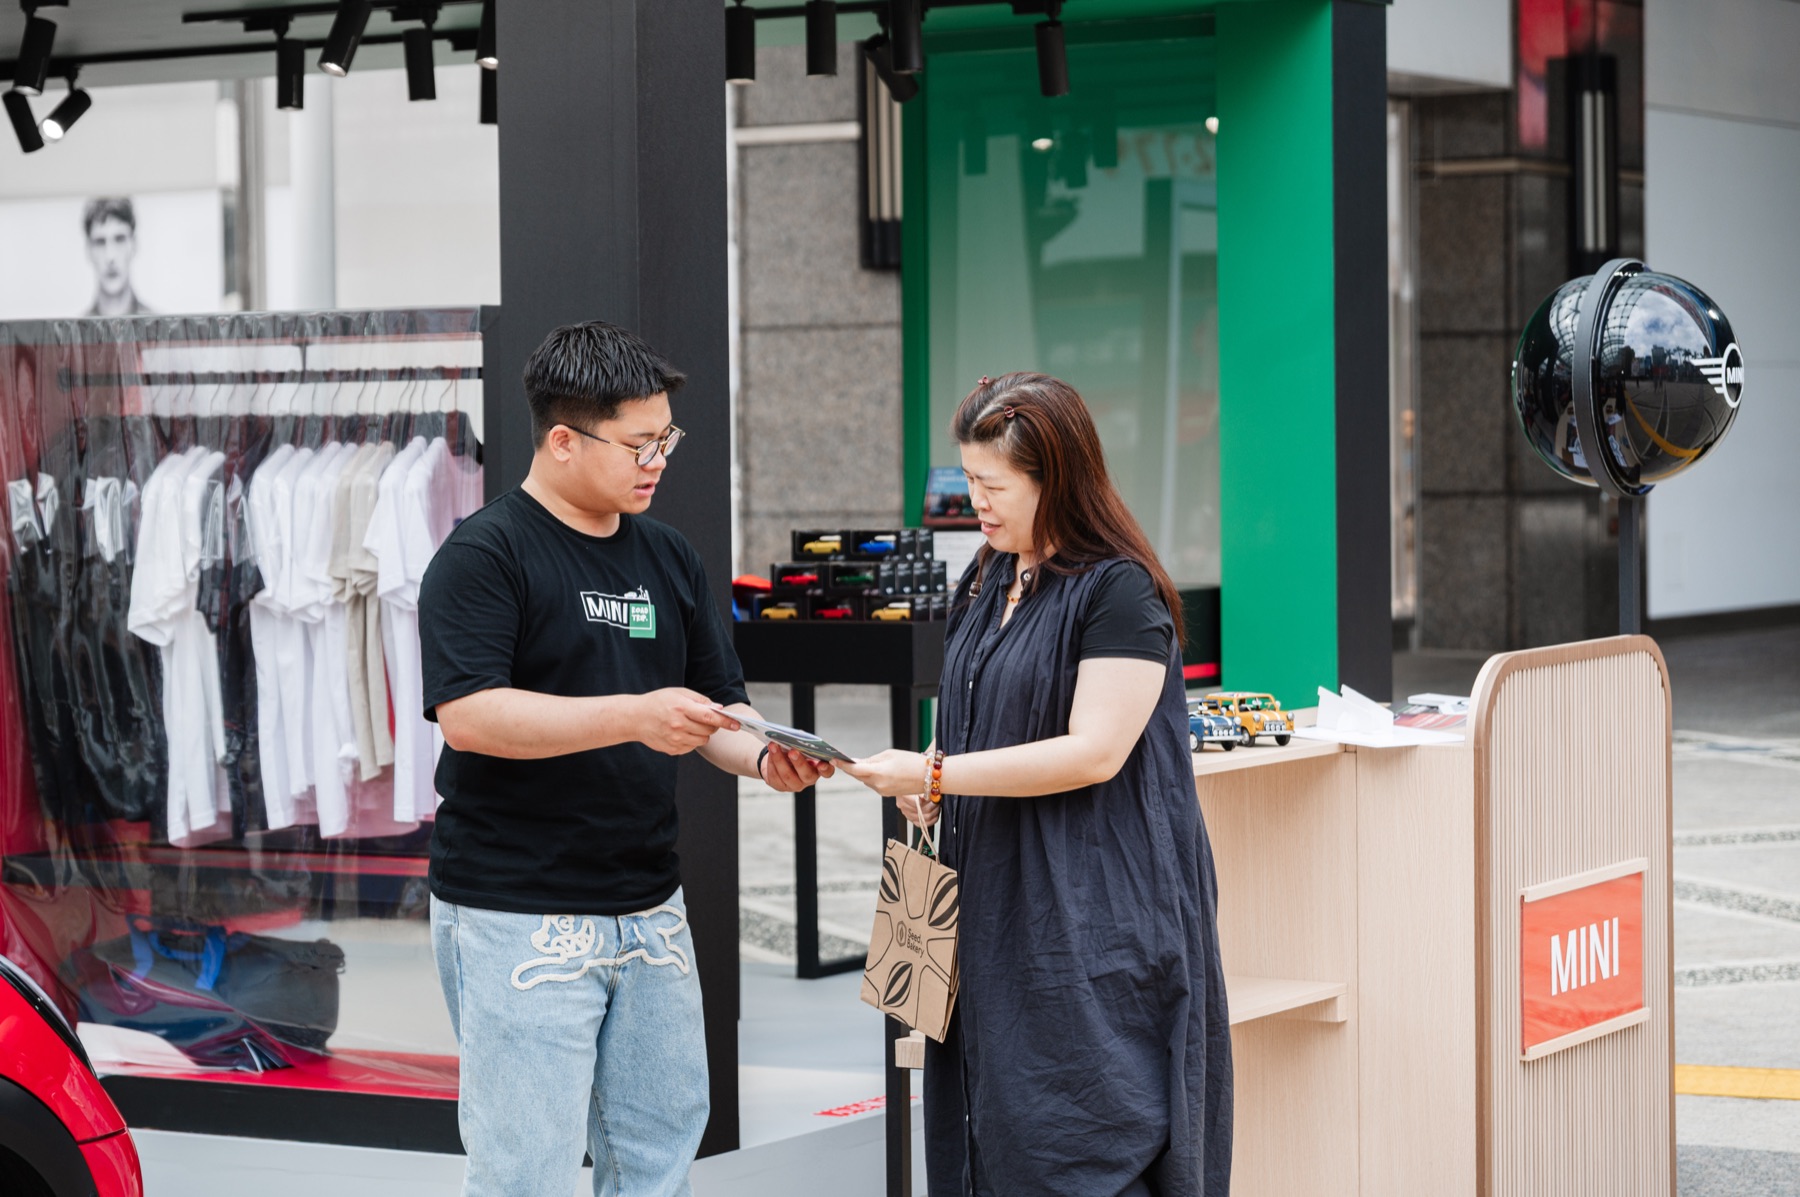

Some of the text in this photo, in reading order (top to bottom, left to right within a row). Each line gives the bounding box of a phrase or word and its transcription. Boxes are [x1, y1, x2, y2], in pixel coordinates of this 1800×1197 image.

[586, 597, 628, 624] MINI
[631, 606, 648, 614] ROAD
[907, 938, 924, 958] Bakery
[1551, 916, 1619, 997] MINI
